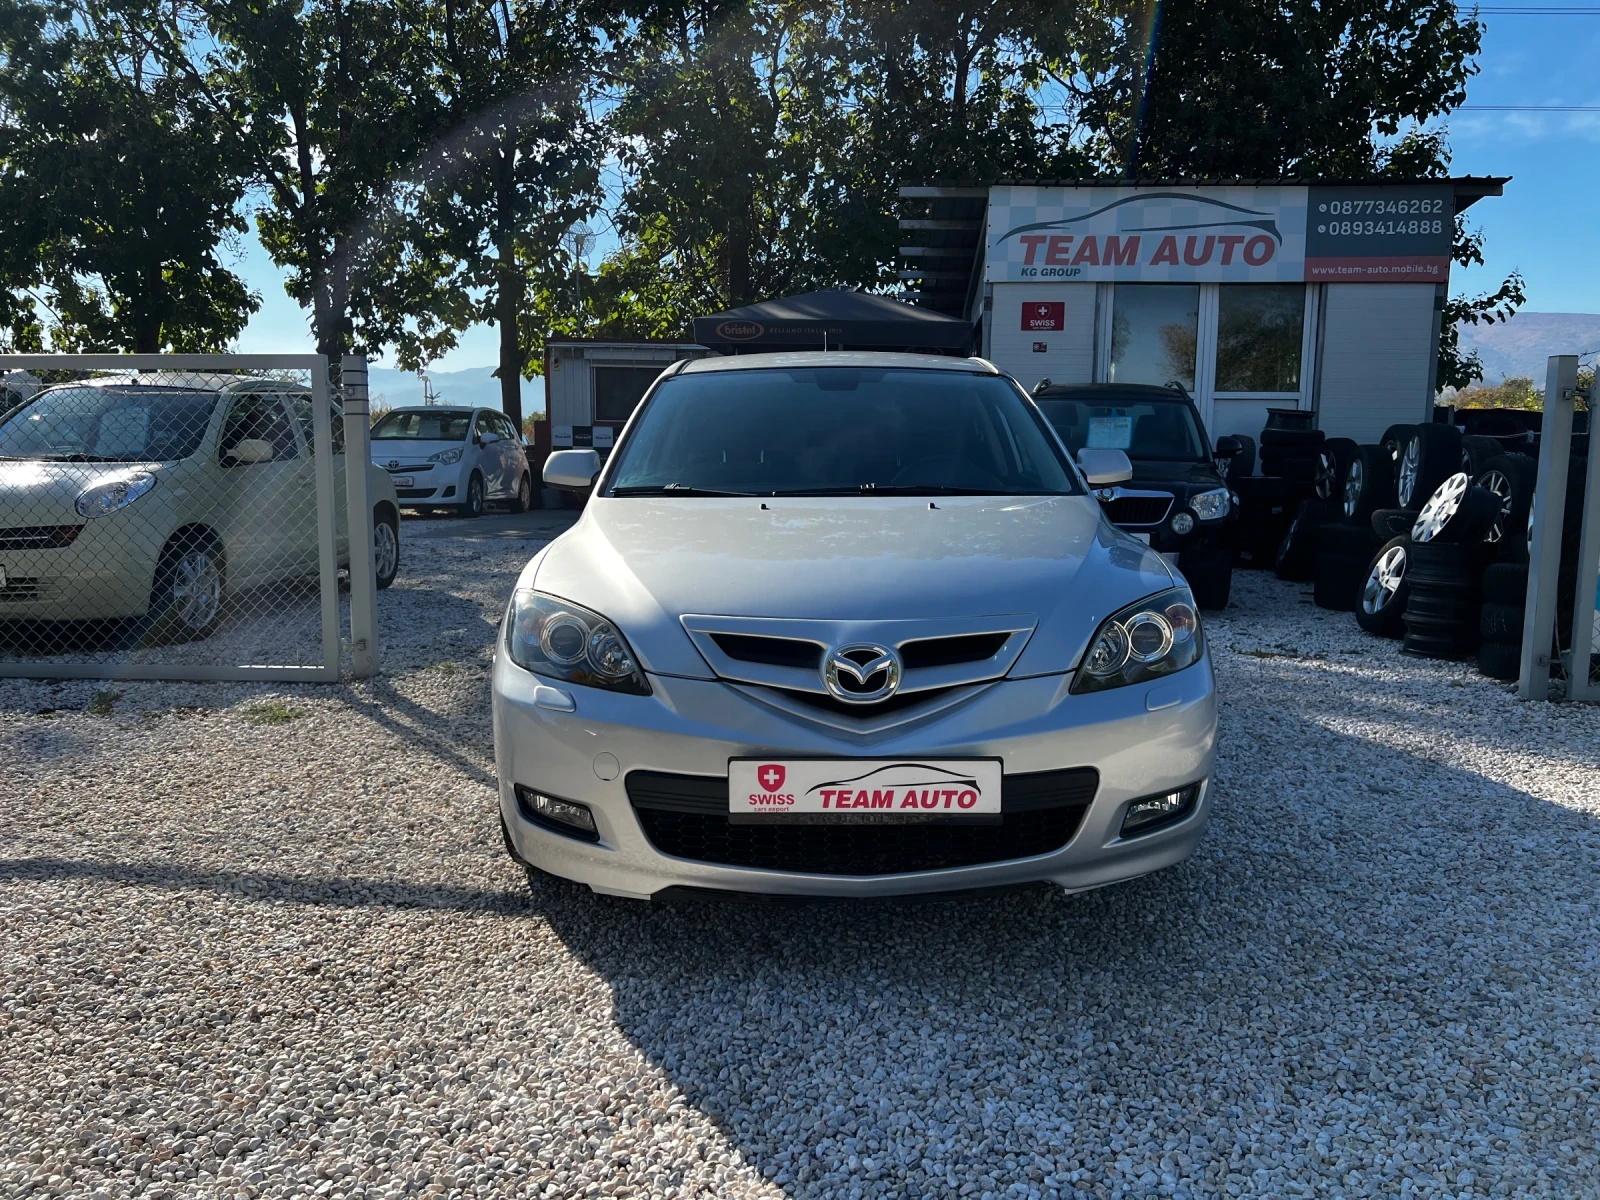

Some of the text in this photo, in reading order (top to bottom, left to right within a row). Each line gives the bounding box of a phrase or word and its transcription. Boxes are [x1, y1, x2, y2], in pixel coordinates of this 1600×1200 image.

[1330, 200, 1443, 215] 0877346262
[1329, 220, 1442, 235] 0893414888
[1019, 234, 1276, 267] TEAM AUTO
[1020, 267, 1081, 277] KG GROUP
[1312, 264, 1439, 275] www.team-auto.mobile.bg
[1030, 319, 1055, 327] SWISS
[749, 794, 795, 805] SWISS
[819, 789, 978, 809] TEAM AUTO
